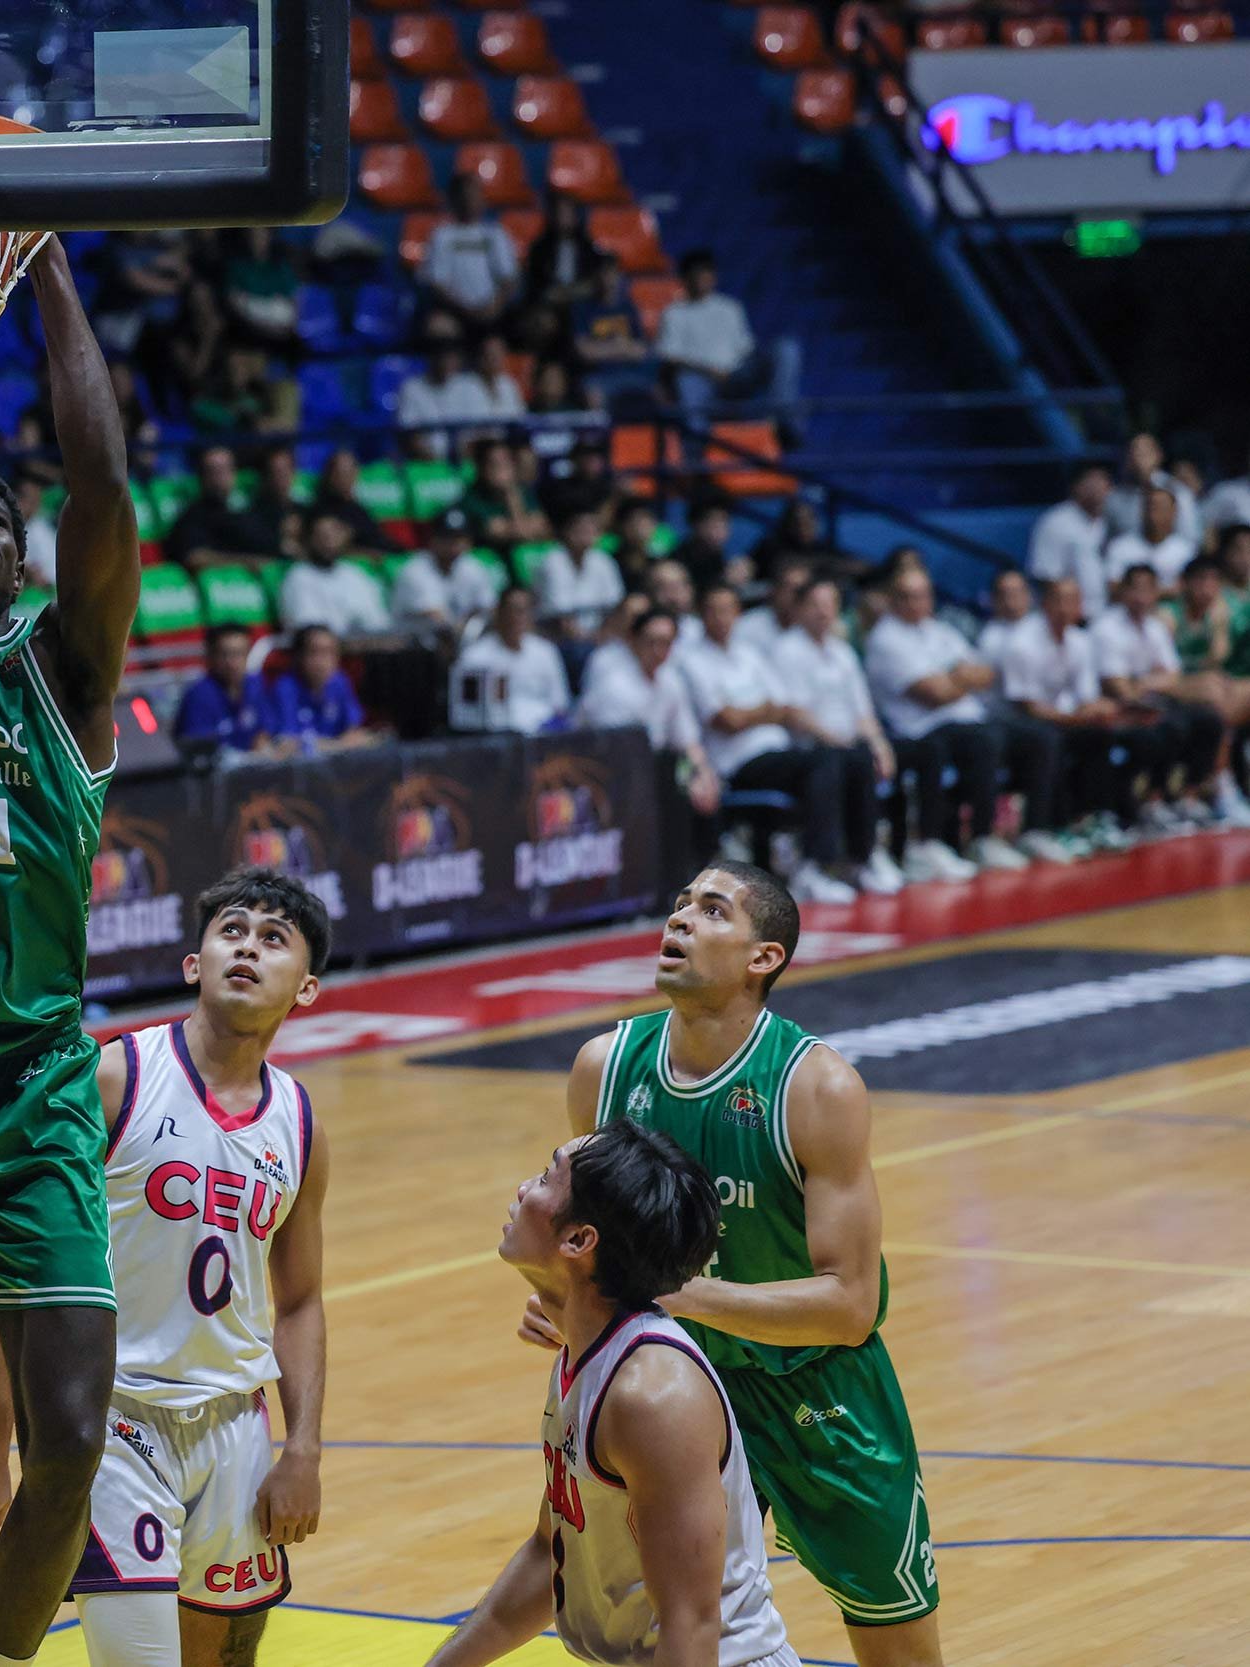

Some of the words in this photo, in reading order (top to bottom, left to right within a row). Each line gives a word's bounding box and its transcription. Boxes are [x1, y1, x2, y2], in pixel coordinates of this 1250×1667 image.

[145, 1160, 282, 1241] CEU
[714, 1176, 754, 1208] Oil
[188, 1235, 233, 1317] 0
[133, 1512, 164, 1562] 0
[205, 1547, 278, 1593] CEU
